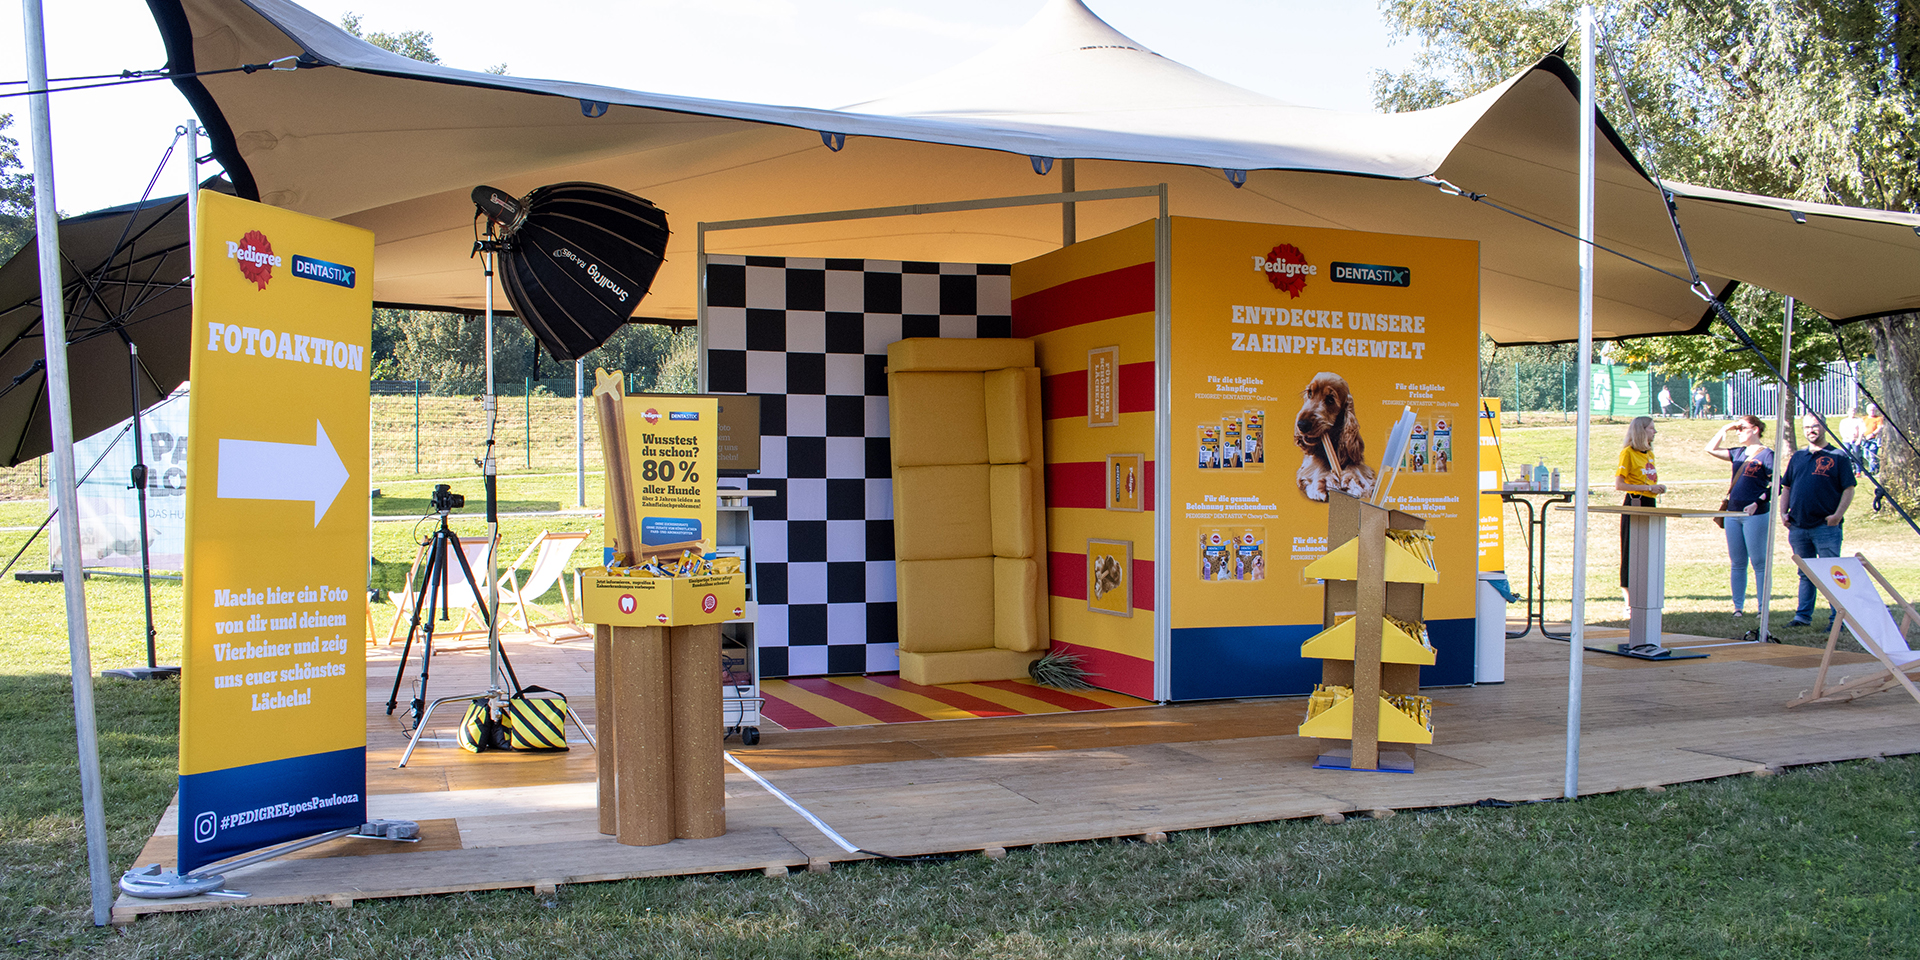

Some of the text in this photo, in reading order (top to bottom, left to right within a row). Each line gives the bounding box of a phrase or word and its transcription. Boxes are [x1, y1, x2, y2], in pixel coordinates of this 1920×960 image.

[227, 241, 282, 267] Pedigree
[562, 248, 629, 302] SmallRig RA-D85
[1253, 255, 1317, 278] Pedigree
[1232, 305, 1425, 334] ENTDECKE UNSERE
[208, 322, 364, 372] FOTOAKTION
[1231, 332, 1425, 360] ZAHNPFLEGEWELT
[1216, 384, 1257, 394] Zahnpflege
[1234, 377, 1264, 385] tägliche
[1420, 384, 1445, 392] tägliche
[642, 433, 698, 446] Wusstest
[642, 446, 699, 457] du schon?
[642, 460, 699, 482] 80 %
[642, 485, 700, 496] aller Hunde
[1408, 496, 1459, 504] Zahngesundheit
[149, 509, 167, 518] DAS
[1186, 503, 1224, 511] Belohnung
[214, 585, 348, 608] Mache hier ein Foto
[215, 611, 347, 634] von dir und deinem
[213, 634, 348, 662] Vierbeiner und zeig
[214, 661, 346, 689] uns euer schönstes
[251, 688, 312, 712] Lächeln!
[220, 792, 359, 830] #PEDIGREEgoesPawlooza
